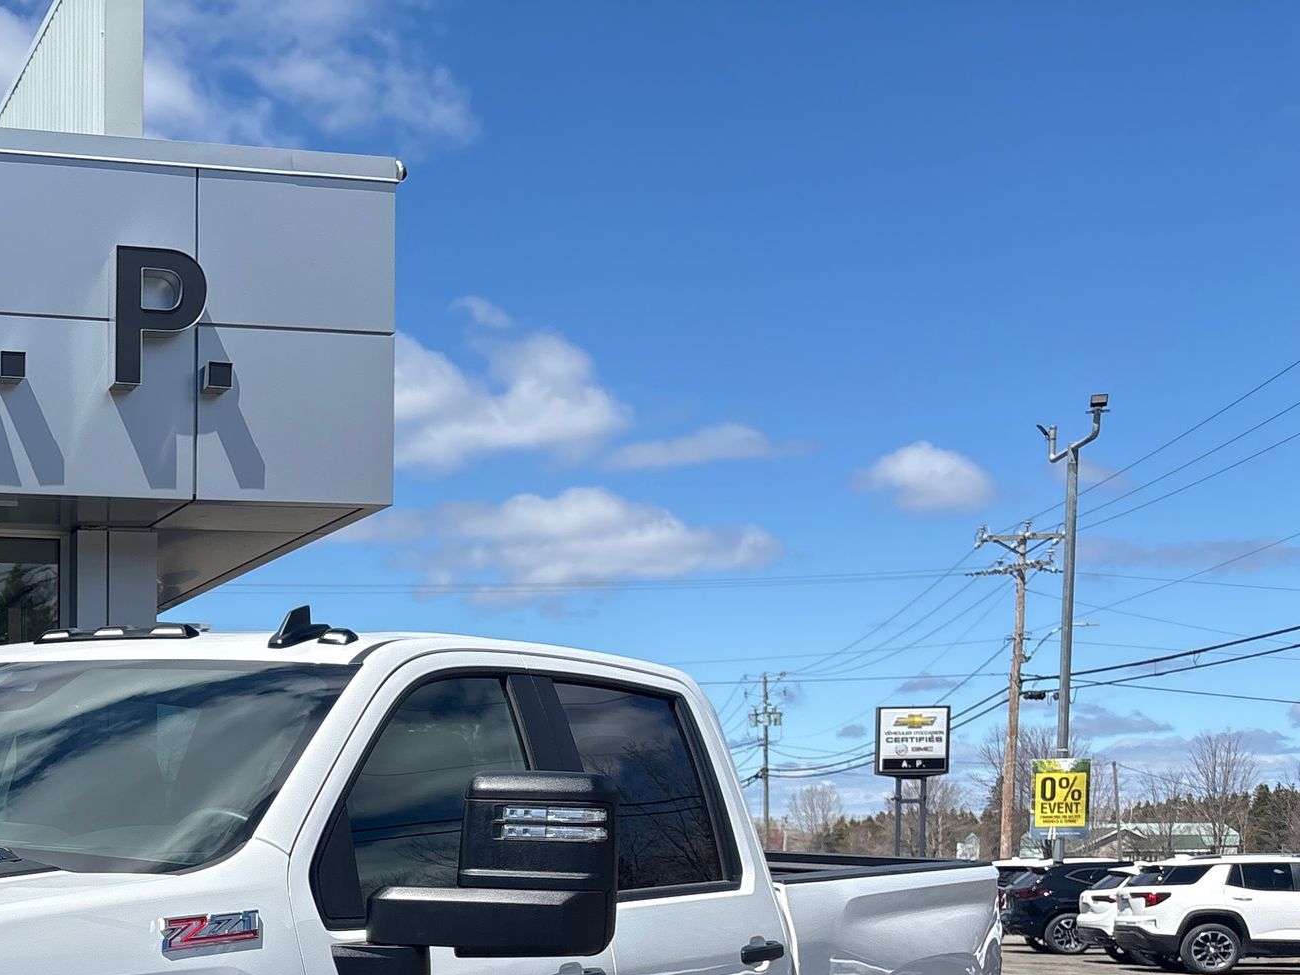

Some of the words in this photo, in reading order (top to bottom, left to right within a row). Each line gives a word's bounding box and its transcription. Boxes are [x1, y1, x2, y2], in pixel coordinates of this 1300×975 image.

[108, 244, 234, 394] P.
[901, 760, 912, 768] A.
[915, 760, 926, 768] P.
[1040, 775, 1082, 802] 0%
[1040, 802, 1081, 814] EVENT
[159, 909, 260, 953] Z71
